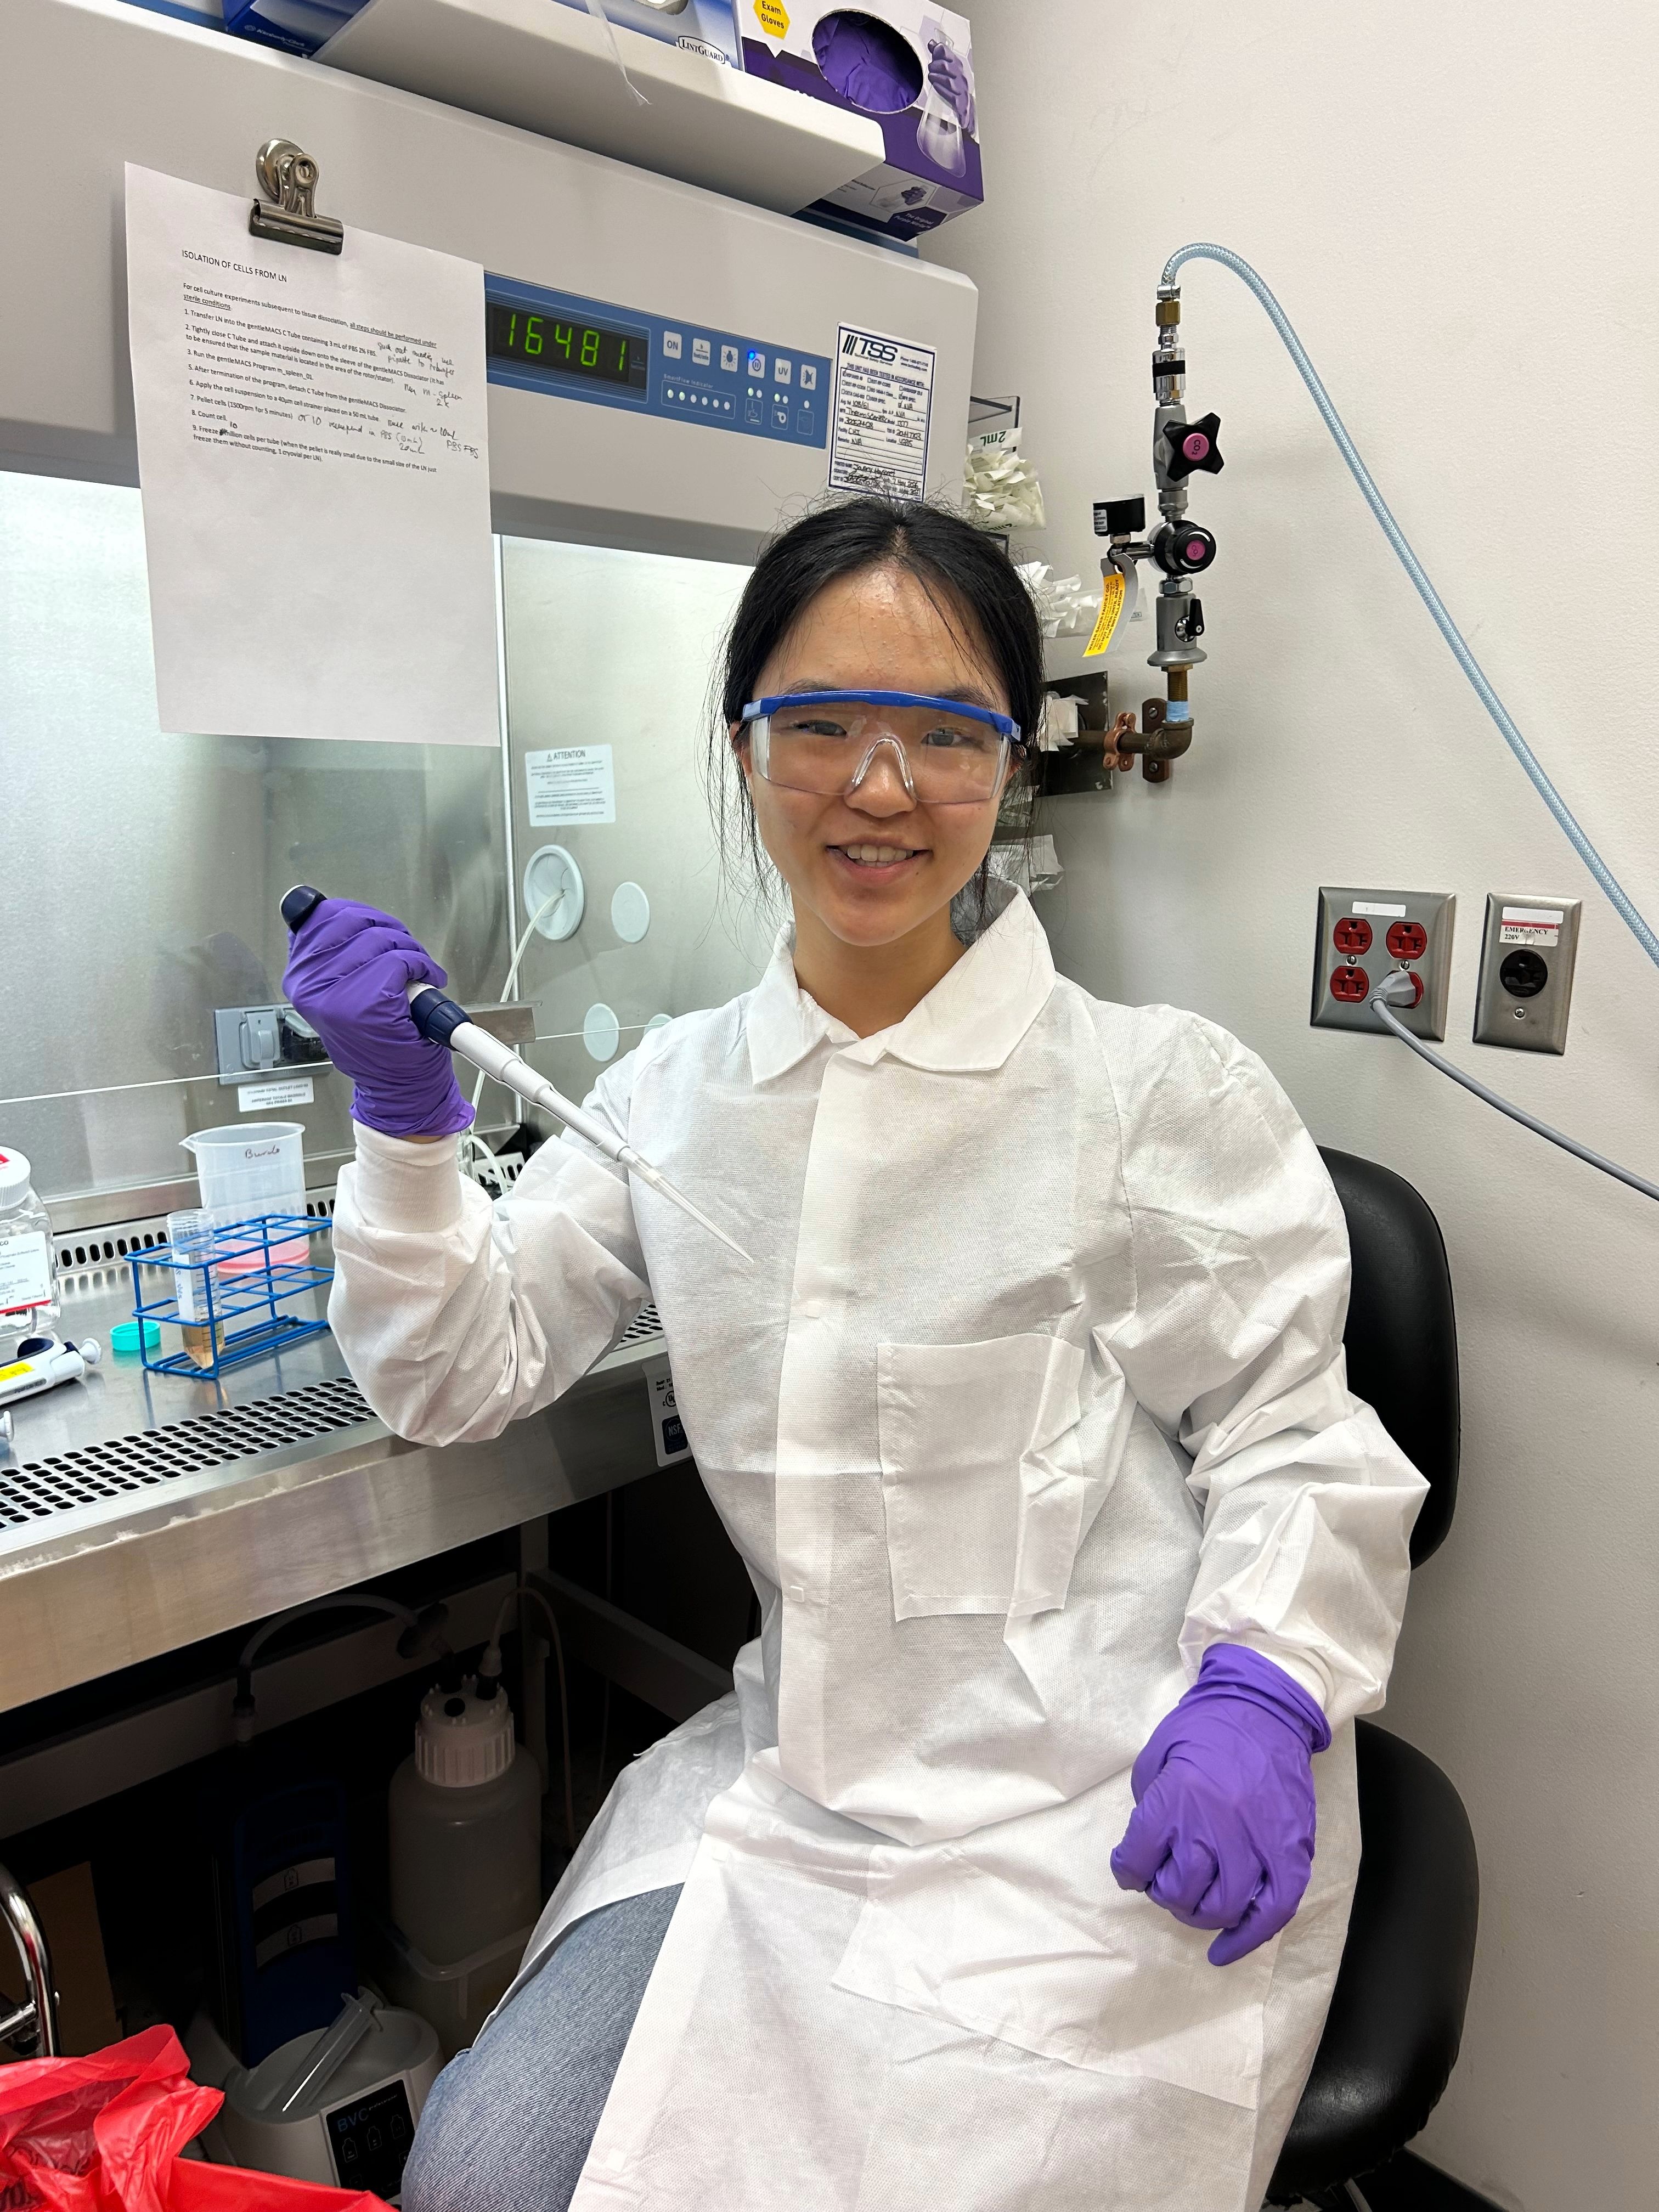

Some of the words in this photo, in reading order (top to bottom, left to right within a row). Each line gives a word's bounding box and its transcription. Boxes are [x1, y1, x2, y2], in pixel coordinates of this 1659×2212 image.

[762, 1, 781, 15] Exam
[761, 13, 785, 29] Gloves
[182, 250, 219, 266] ISOLATION
[233, 264, 253, 274] CELLS
[255, 269, 276, 279] FROM
[184, 294, 200, 302] sterile
[204, 289, 223, 297] culture
[225, 294, 260, 306] experiments
[262, 301, 294, 314] subsequent
[302, 311, 317, 319] tissue
[318, 314, 348, 327] dissociation,
[357, 324, 369, 332] steps
[371, 328, 386, 336] should
[395, 334, 421, 345] performed
[191, 310, 214, 320] Transfer
[247, 323, 281, 335] gentleMACS
[302, 335, 328, 346] containing
[509, 314, 626, 371] 16481
[667, 340, 678, 350] ON
[859, 337, 898, 362] TSS
[192, 325, 210, 336] Tightly
[283, 345, 300, 354] upside
[302, 349, 316, 357] down
[340, 358, 356, 366] sleeve
[373, 365, 403, 377] gentleMACS
[202, 338, 225, 347] ensured
[251, 348, 270, 357] sample
[272, 352, 293, 361] material
[300, 358, 318, 366] located
[217, 356, 251, 367] gentleMACS
[253, 362, 276, 372] Program
[778, 367, 788, 376] UV
[196, 381, 212, 390] Apply
[235, 388, 266, 399] suspension
[211, 369, 244, 381] termination
[263, 380, 287, 390] program,
[289, 385, 306, 393] detach
[325, 392, 337, 400] from
[348, 397, 378, 408] gentleMACS
[197, 396, 213, 404] Pellet
[269, 410, 293, 419] minutes)
[198, 411, 215, 419] Count
[199, 426, 218, 435] Freeze
[193, 435, 211, 443] freeze
[229, 441, 251, 449] without
[554, 749, 586, 760] ATTENTION
[1505, 927, 1548, 935] EMERGENCY
[668, 1423, 681, 1436] NSF
[337, 2108, 369, 2132] BVC
